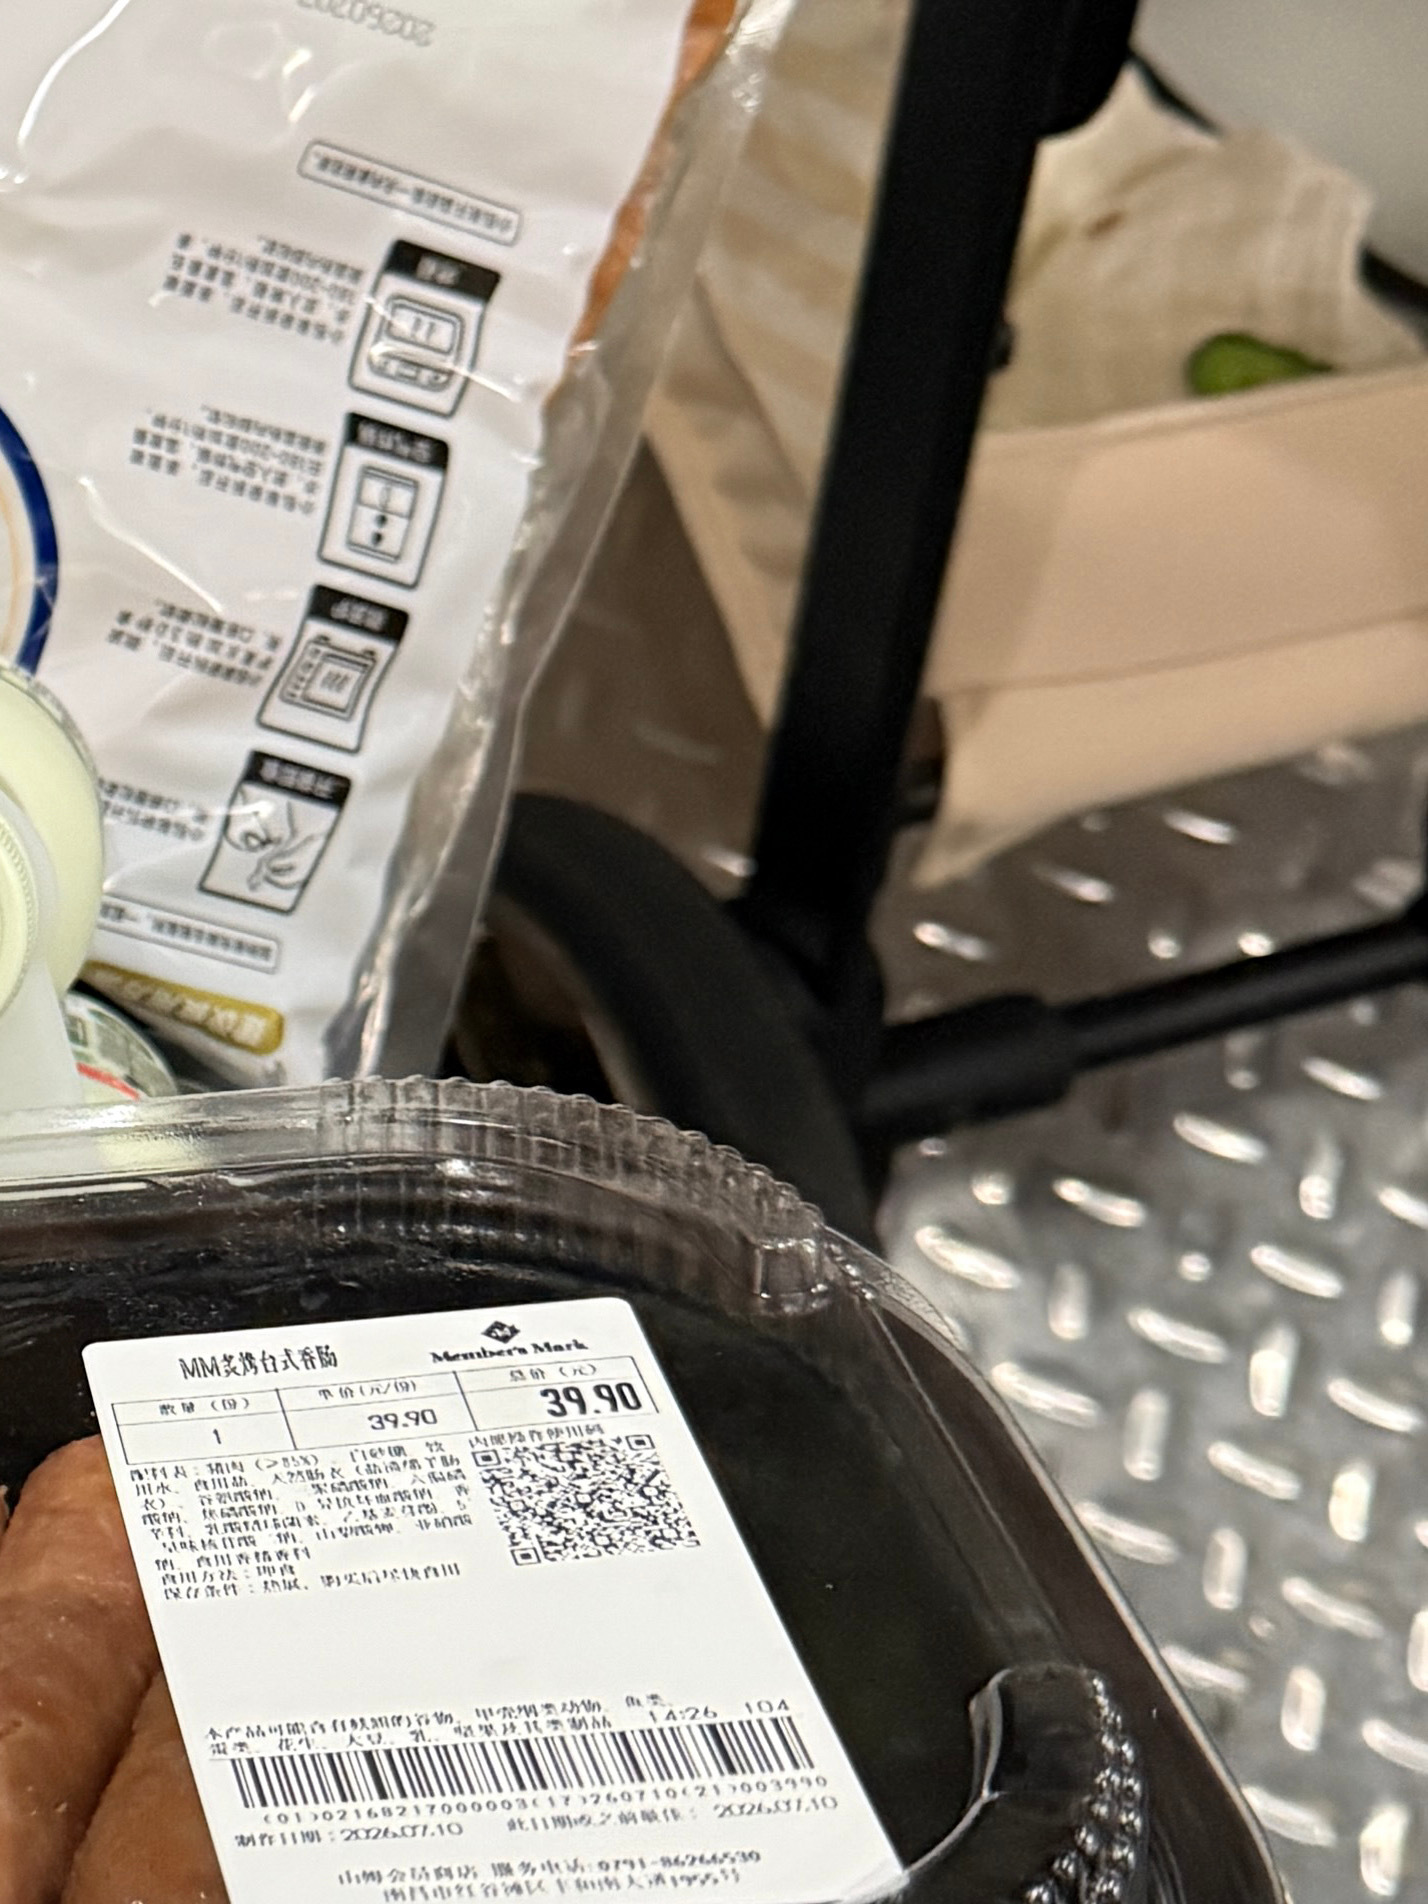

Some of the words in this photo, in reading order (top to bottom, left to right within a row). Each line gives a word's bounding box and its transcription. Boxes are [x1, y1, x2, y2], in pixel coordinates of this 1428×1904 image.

[179, 1345, 339, 1379] MM炙烤台式香肠
[429, 1345, 528, 1364] Member's
[533, 1339, 590, 1354] Mark
[212, 1429, 222, 1445] 1
[367, 1409, 438, 1431] 39.90
[540, 1382, 643, 1417] 39.90
[649, 1706, 718, 1723] 14:26
[745, 1699, 790, 1715] 104
